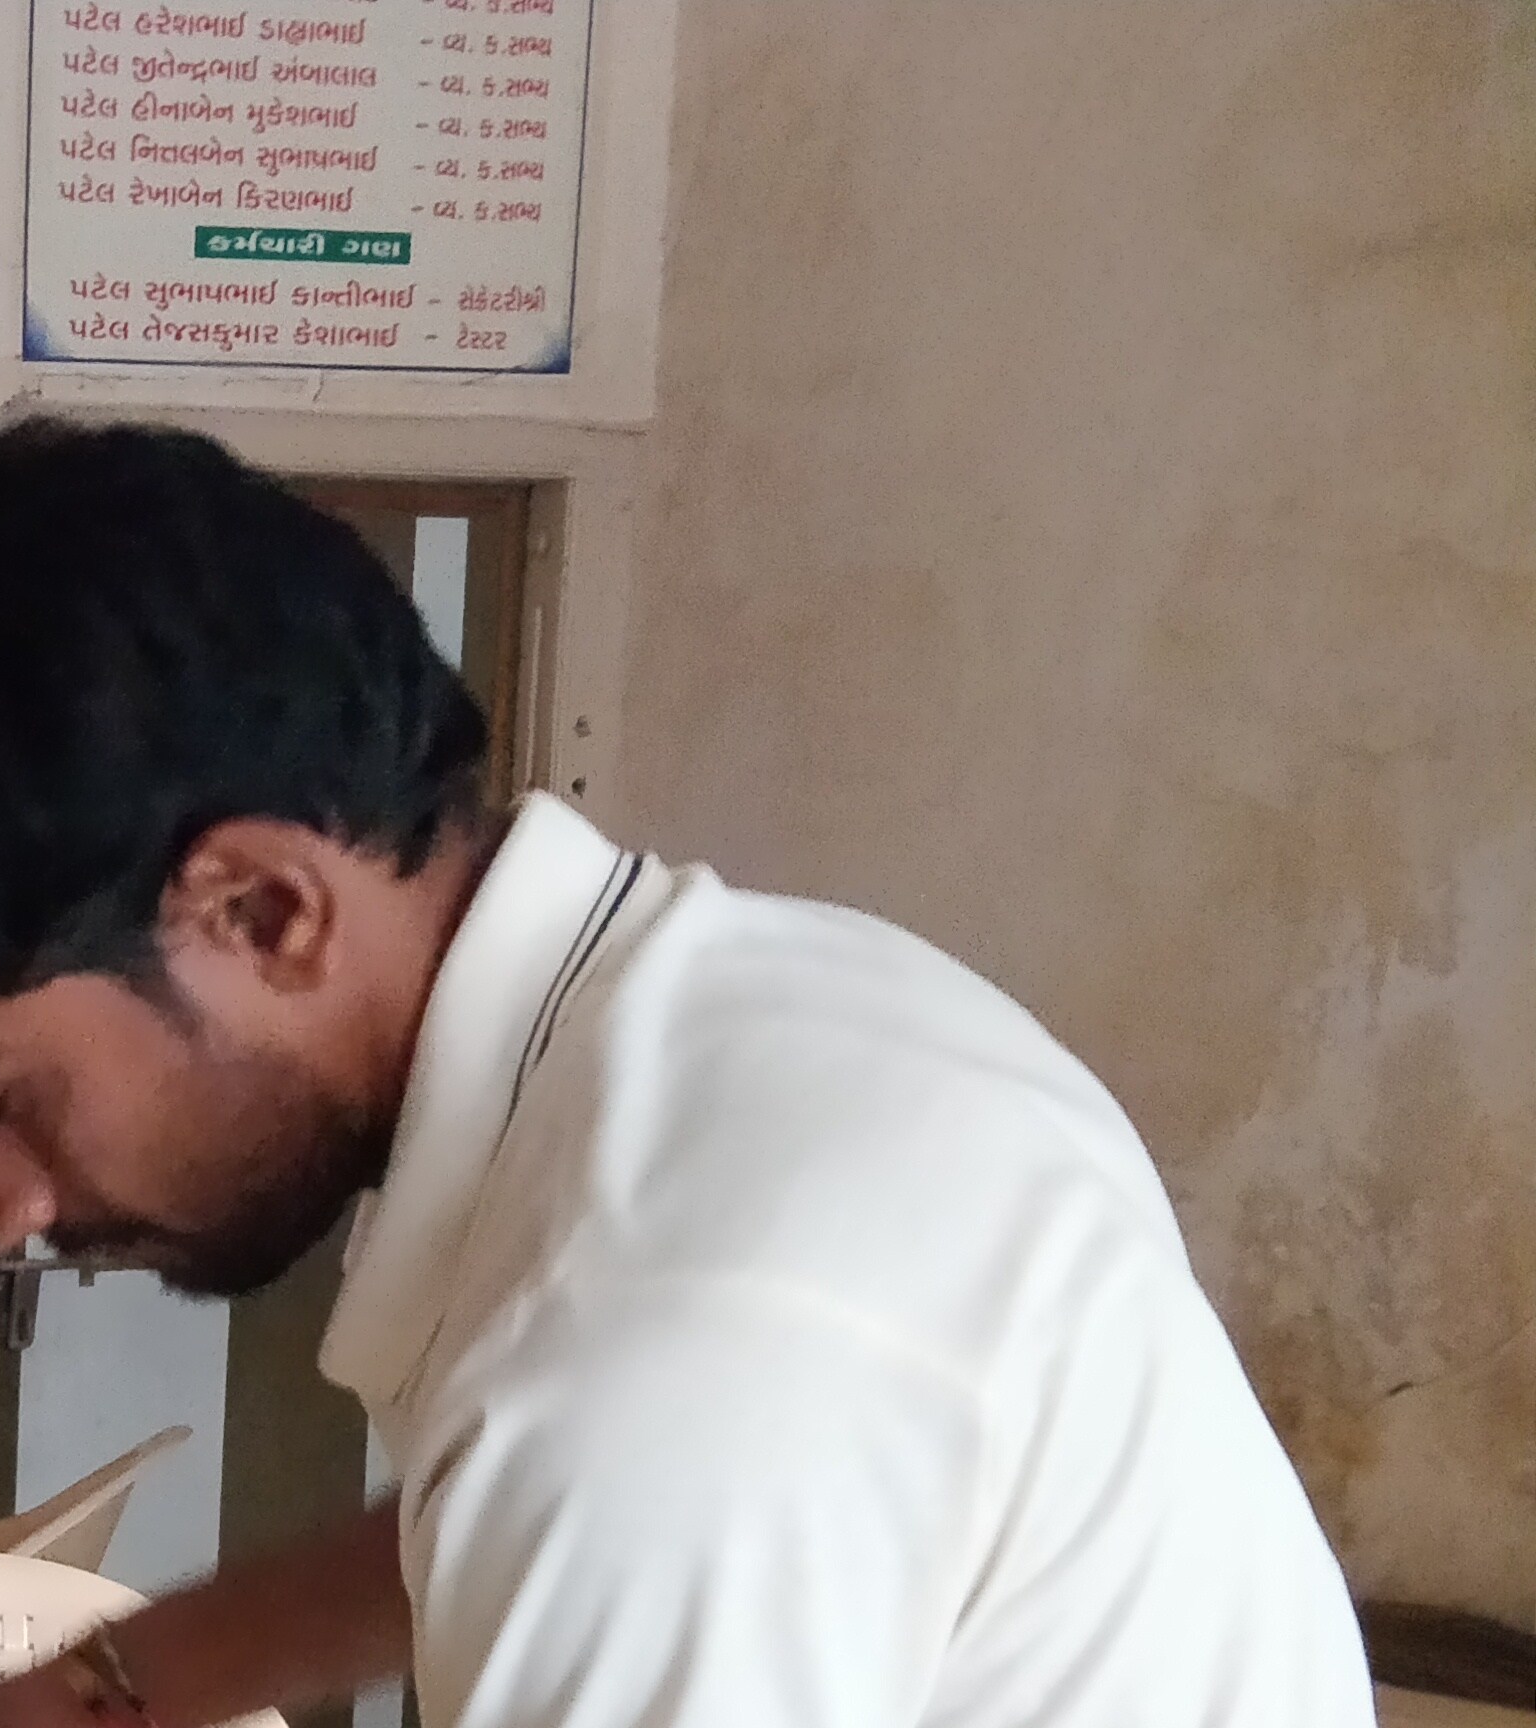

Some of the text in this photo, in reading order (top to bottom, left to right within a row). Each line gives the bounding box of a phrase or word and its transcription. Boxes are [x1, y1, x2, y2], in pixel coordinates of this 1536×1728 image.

[64, 2, 120, 31] પટેલ
[135, 5, 248, 38] હરેશભાઈ
[62, 44, 118, 75] પટેલ
[132, 47, 261, 83] જીતેન્દ્રભાઈ
[273, 56, 377, 87] અંબાલાલ
[61, 87, 117, 117] પટેલ
[131, 91, 233, 123] હીનાબેન
[247, 97, 356, 133] મુકેશભાઈ
[60, 131, 116, 161] પટેલ
[58, 173, 114, 203] પટેલ
[129, 177, 222, 209] રેખાબેન
[237, 180, 354, 213] કિરણભાઈ
[208, 231, 401, 258] કર્મચારી ગણ
[70, 272, 130, 301] પટેલ
[291, 280, 417, 309] કાન્તીભાઈ
[69, 312, 129, 341] પટેલ
[143, 314, 280, 353] તેજસકુમાર
